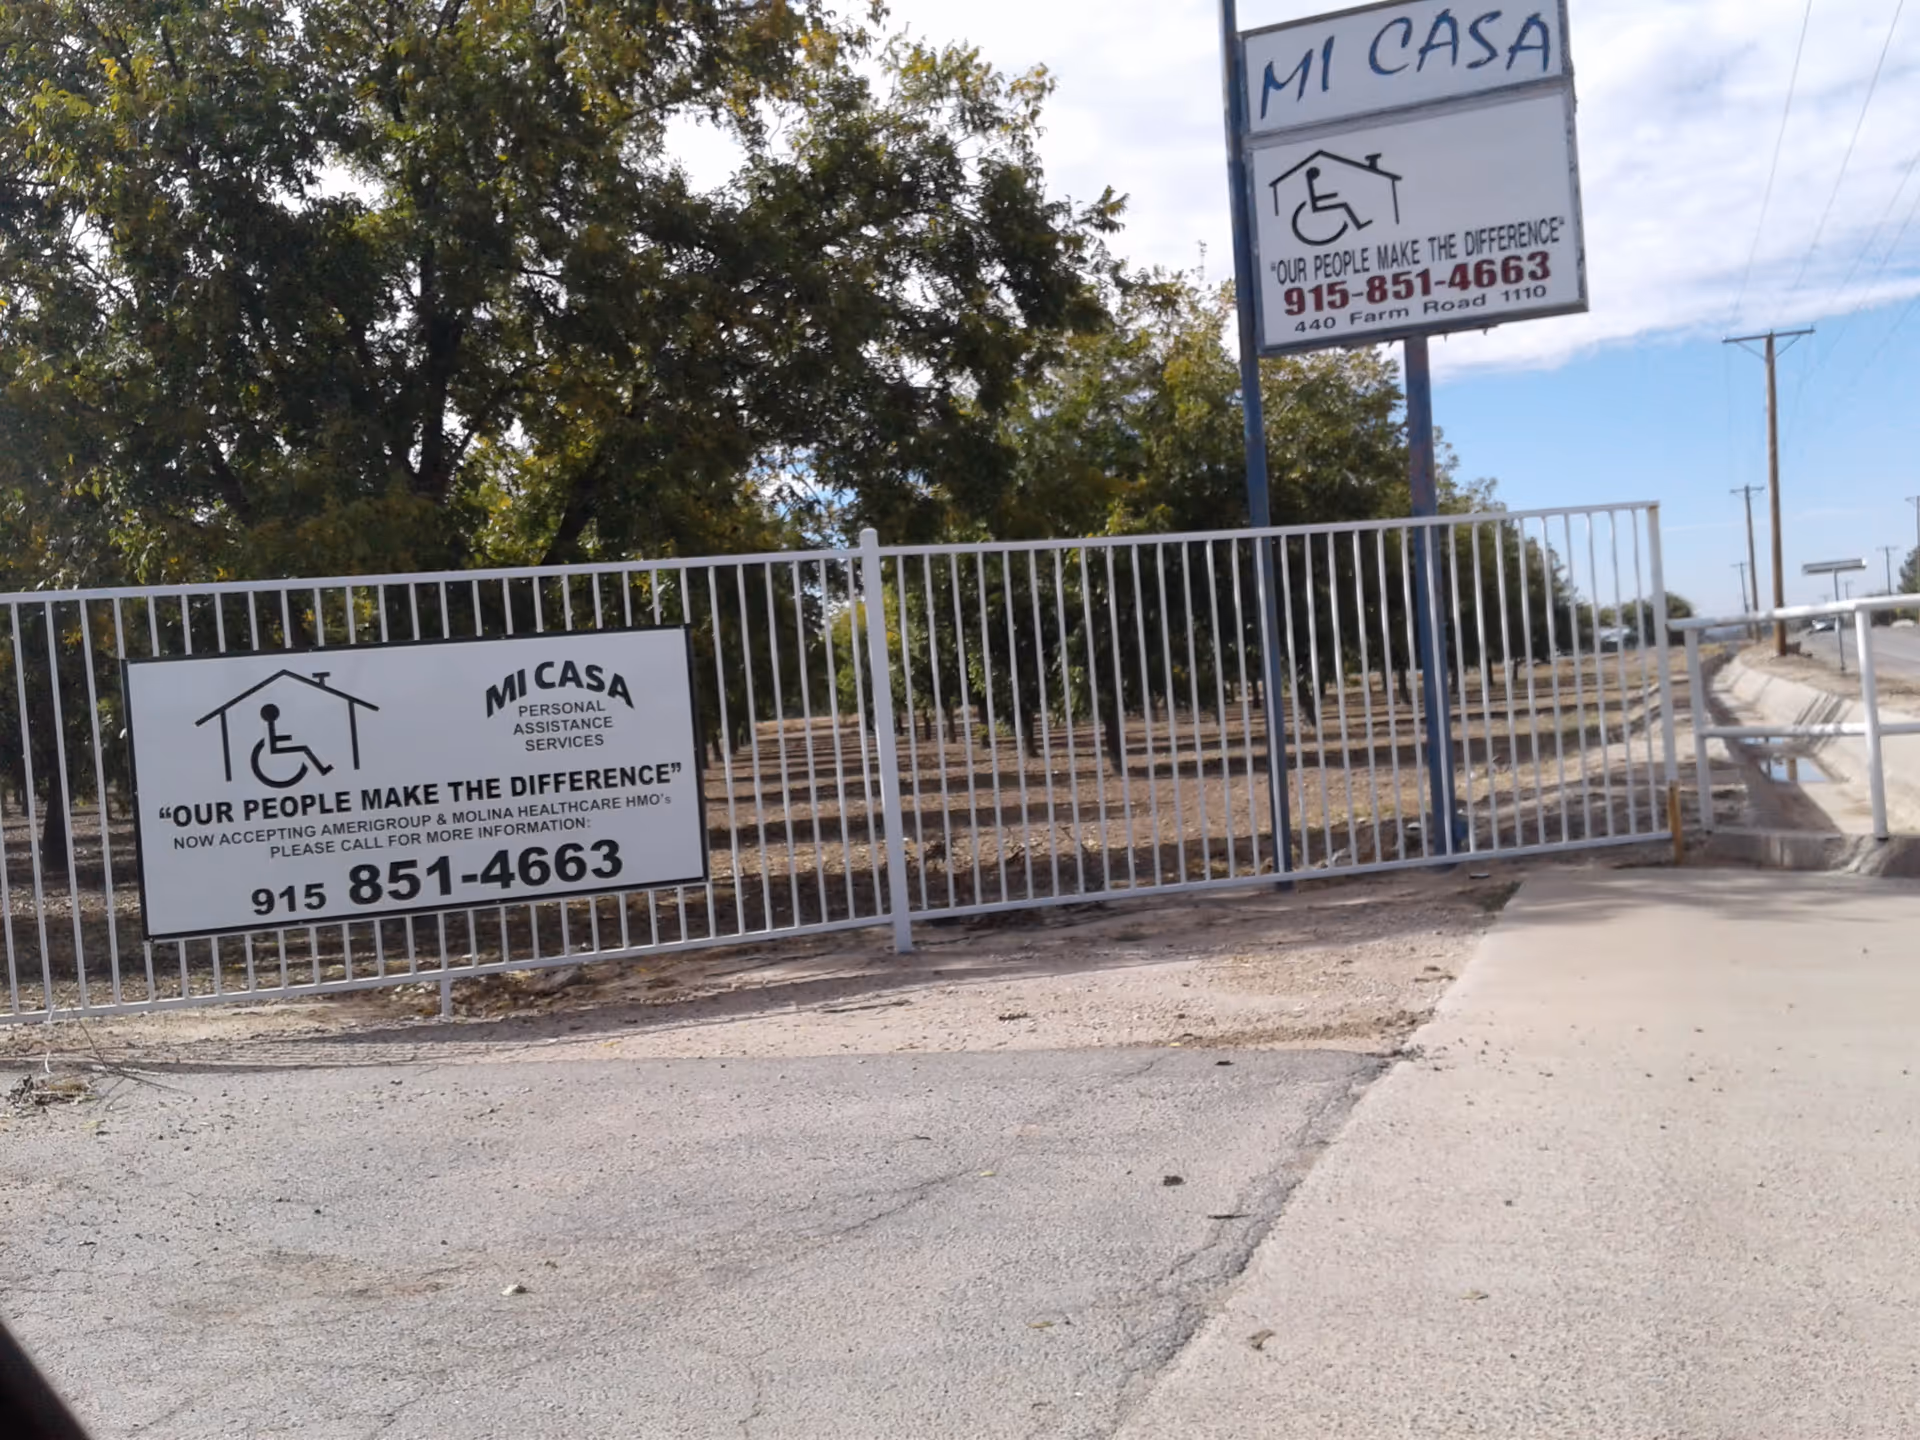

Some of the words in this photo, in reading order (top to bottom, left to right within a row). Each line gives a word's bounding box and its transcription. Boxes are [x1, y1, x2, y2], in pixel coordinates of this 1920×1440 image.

[1260, 35, 1335, 120] MI
[1368, 8, 1551, 76] CASA
[1314, 247, 1370, 280] PEOPLE
[1377, 239, 1420, 270] MAKE
[1428, 233, 1457, 262] THE
[1284, 250, 1551, 316] 915-851-4663
[1295, 316, 1336, 333] 440
[1350, 307, 1409, 325] Farm
[1423, 293, 1486, 314] Road
[1501, 284, 1547, 302] 1110
[486, 668, 527, 719] MI
[534, 660, 635, 709] CASA
[518, 700, 606, 717] PERSONAL
[513, 716, 613, 735] ASSISTANCE
[525, 734, 604, 752] SERVICES
[174, 835, 214, 850] NOW
[219, 824, 317, 846] ACCEPTING
[321, 815, 431, 836] AMERIGROUP
[436, 812, 447, 826] &
[452, 807, 514, 824] MOLINA
[518, 796, 622, 817] HEALTHCARE
[243, 791, 352, 821] PEOPLE
[361, 783, 439, 811] MAKE
[448, 778, 501, 802] THE
[270, 841, 336, 859] PLEASE
[340, 836, 383, 852] CALL
[388, 832, 422, 847] FOR
[426, 827, 474, 844] MORE
[478, 817, 592, 839] INFORMATION:
[251, 882, 327, 916] 915
[349, 839, 623, 905] 851-4663
